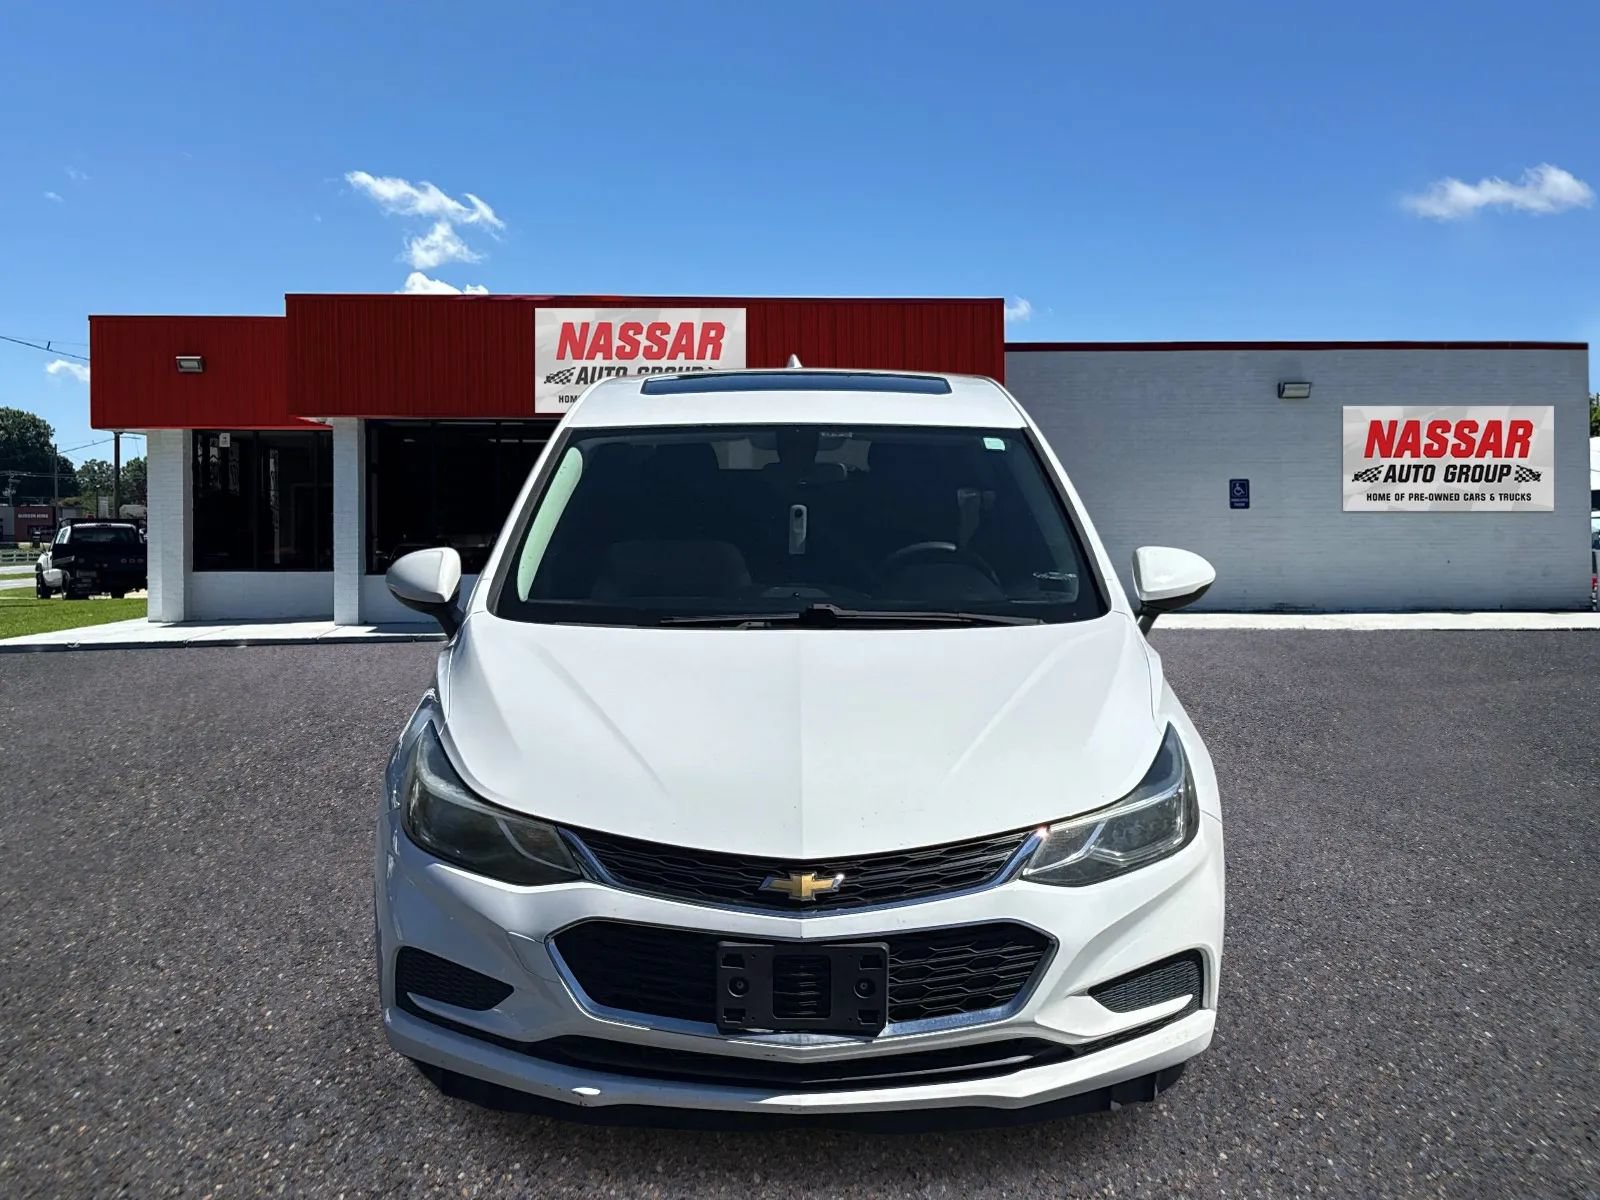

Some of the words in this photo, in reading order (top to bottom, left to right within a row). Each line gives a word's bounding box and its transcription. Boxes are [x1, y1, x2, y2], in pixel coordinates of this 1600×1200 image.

[555, 321, 726, 361] NASSAR
[558, 395, 580, 403] HOM
[1363, 419, 1534, 458] NASSAR
[1383, 464, 1436, 483] AUTO
[1443, 464, 1512, 483] GROUP
[1366, 493, 1391, 502] HOME
[1394, 493, 1405, 502] OF
[1408, 493, 1460, 502] PRE-OWNED
[1463, 493, 1486, 502] CARS
[1489, 493, 1495, 502] &
[1499, 493, 1532, 502] TRUCKS
